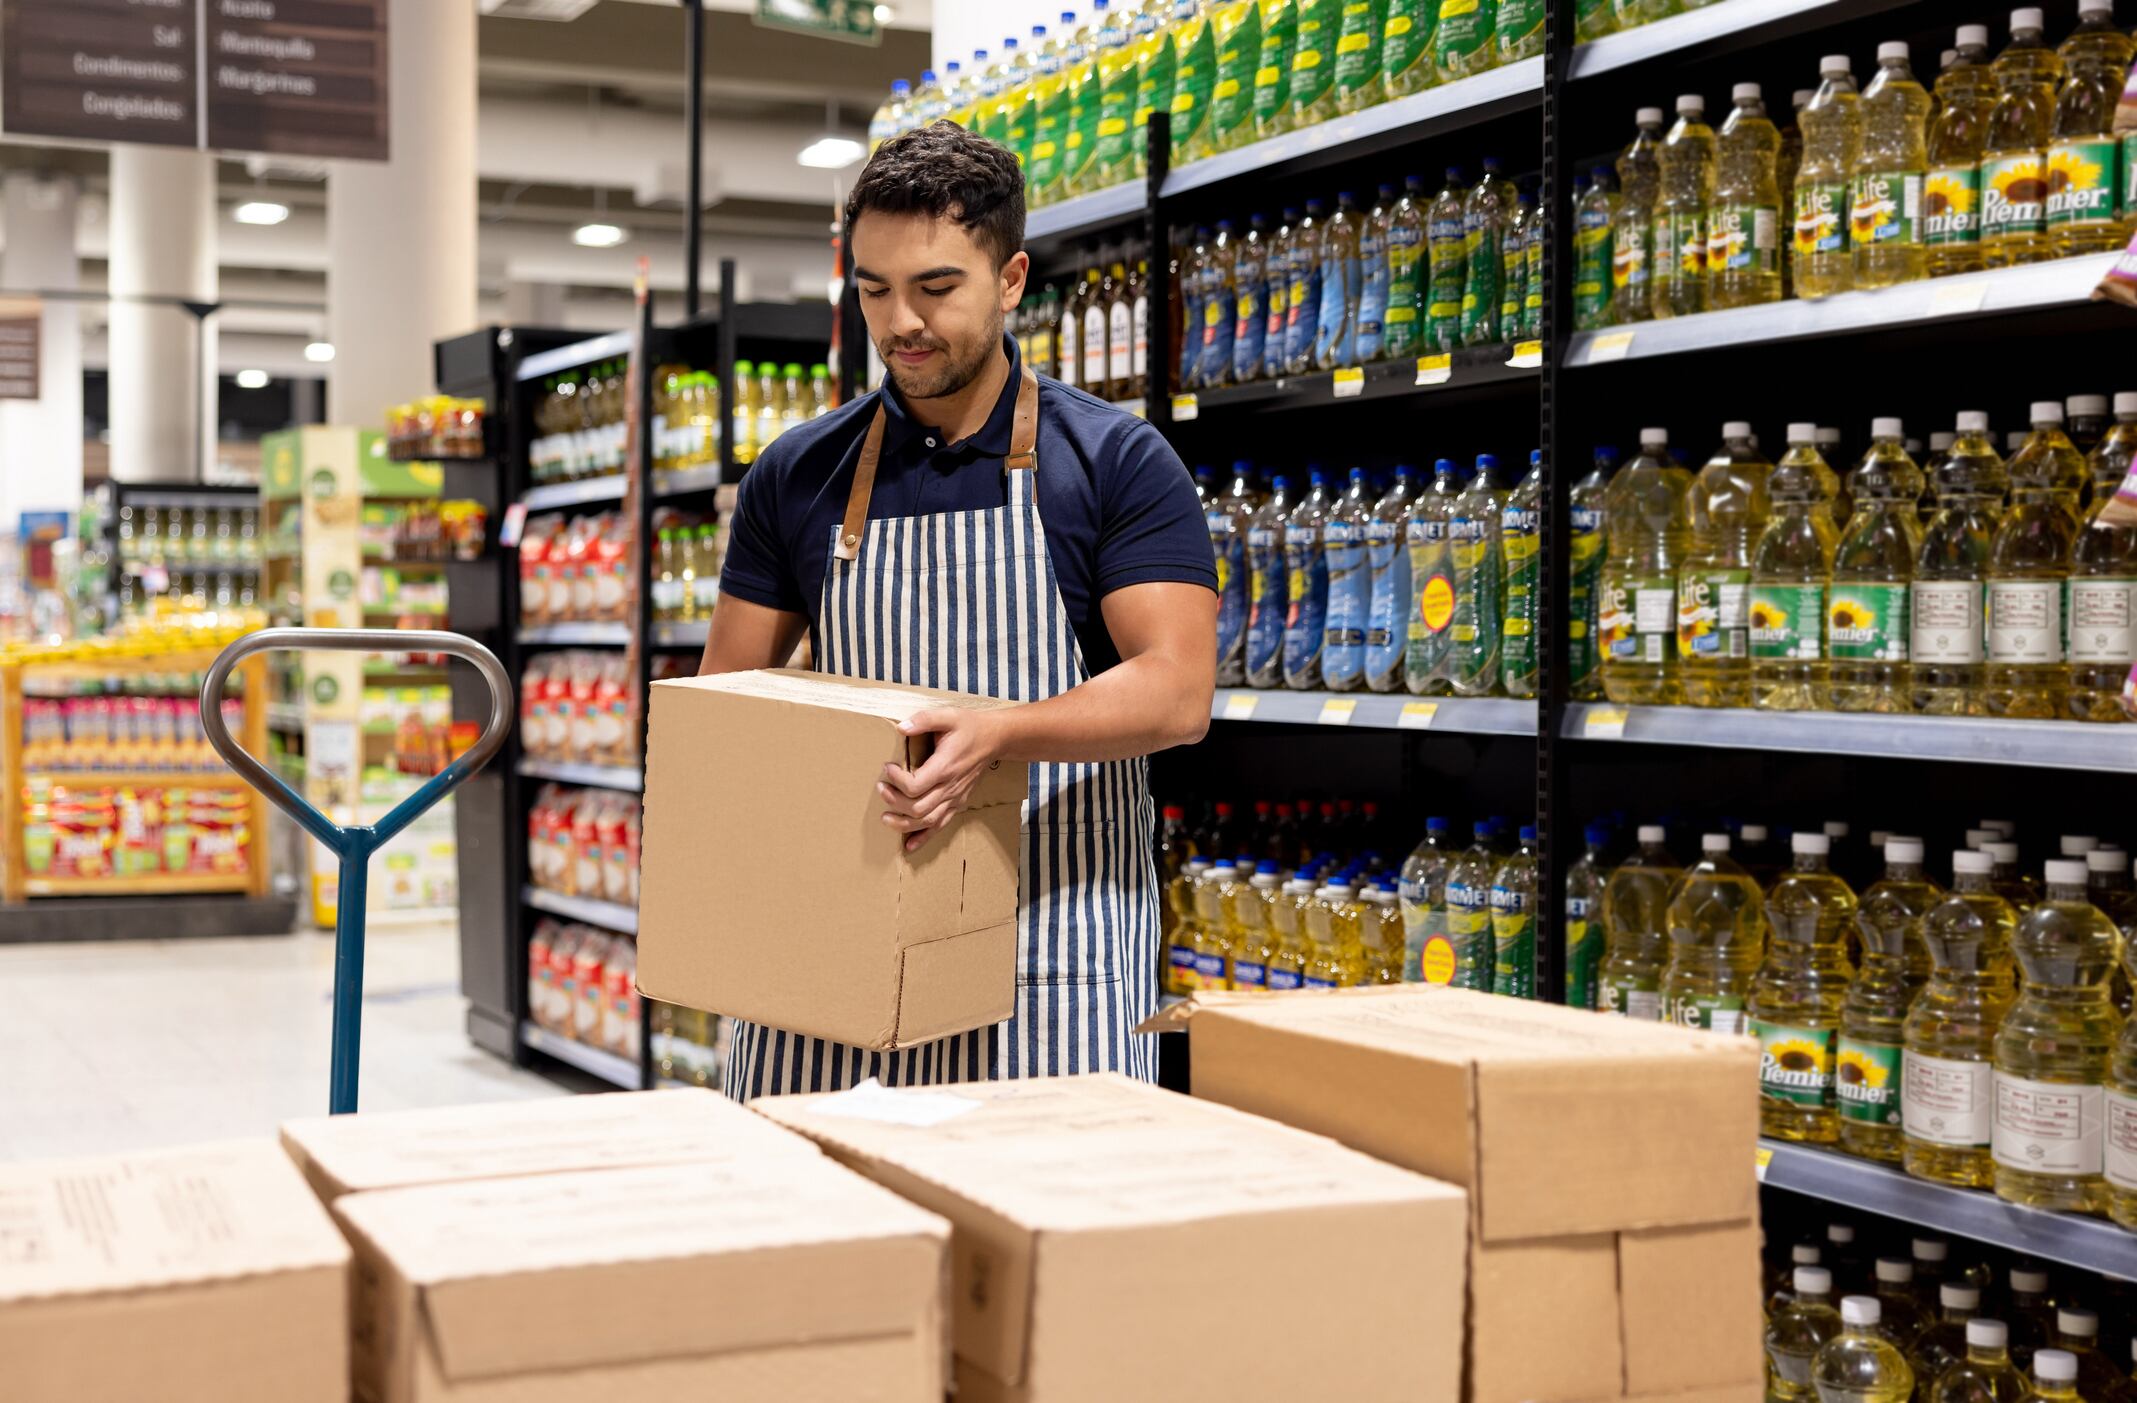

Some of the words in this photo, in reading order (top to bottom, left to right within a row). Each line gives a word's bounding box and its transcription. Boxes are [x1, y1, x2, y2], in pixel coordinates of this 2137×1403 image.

[152, 24, 181, 48] Sal
[218, 30, 315, 61] Mantequilla
[73, 52, 185, 83] Condimentos
[218, 65, 316, 96] Margarinas
[83, 90, 185, 120] Congelados
